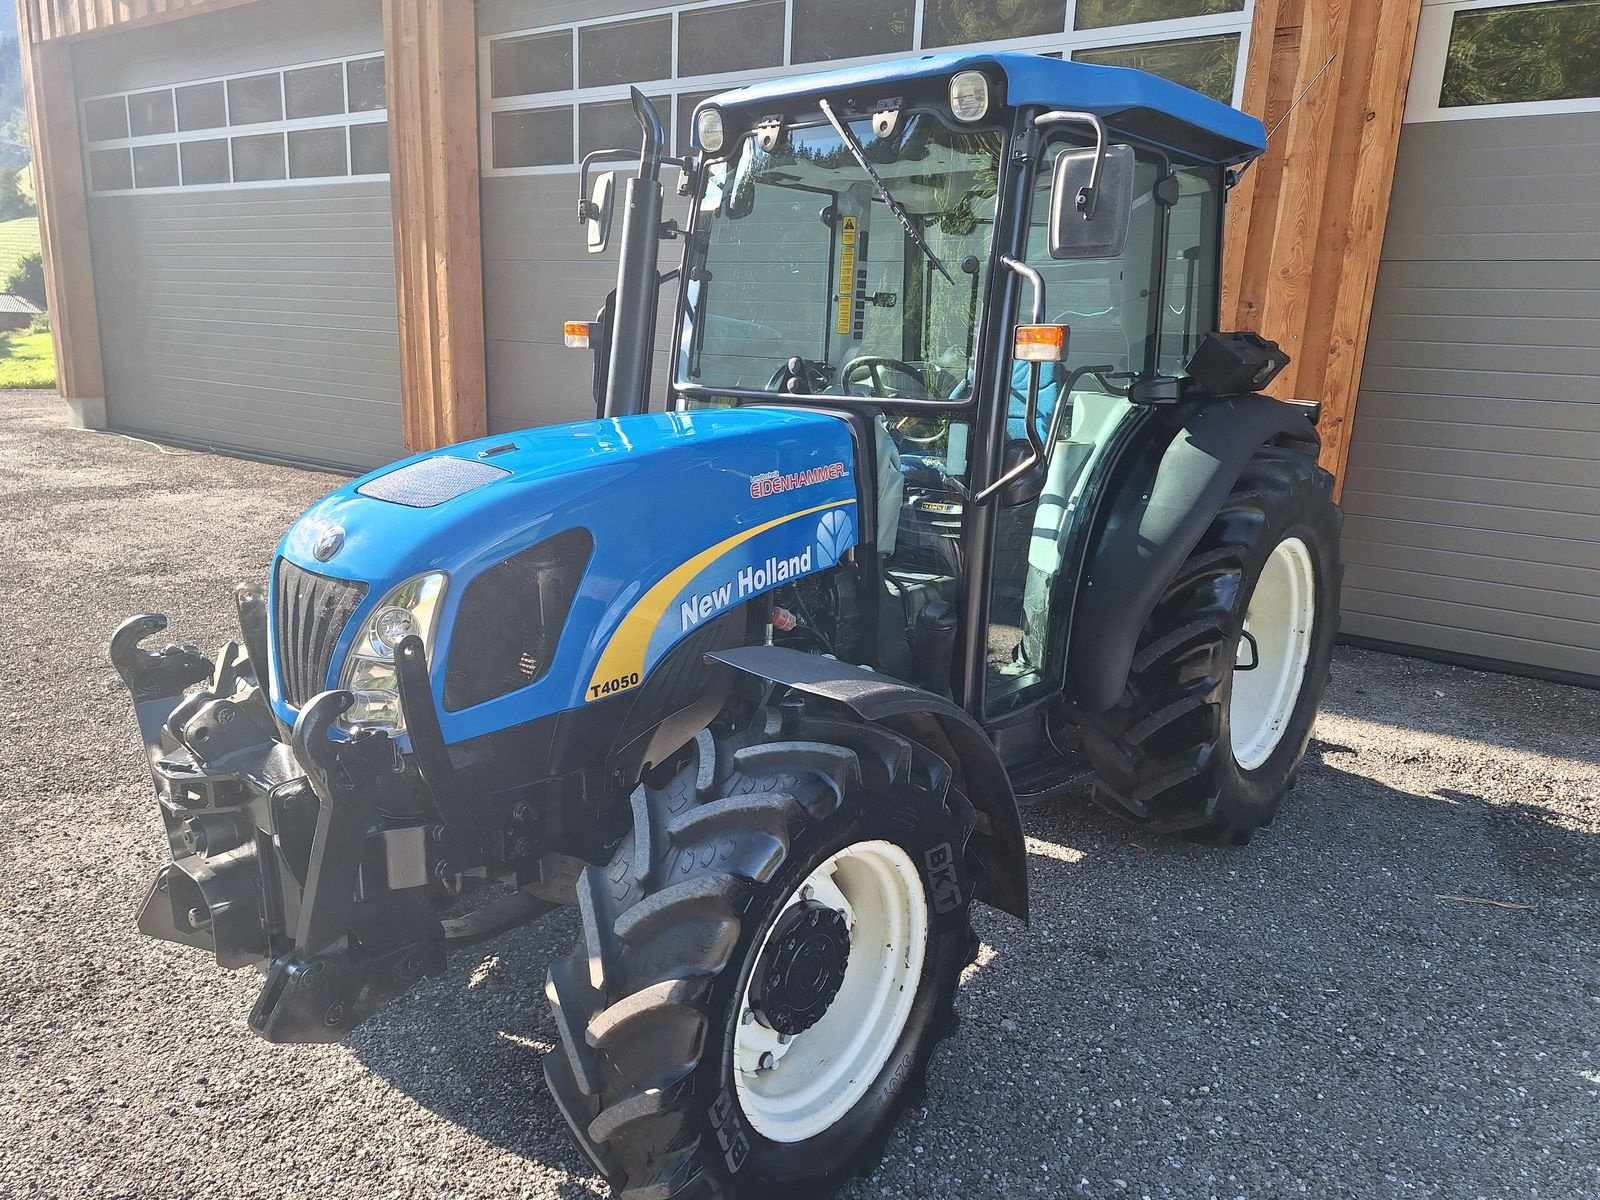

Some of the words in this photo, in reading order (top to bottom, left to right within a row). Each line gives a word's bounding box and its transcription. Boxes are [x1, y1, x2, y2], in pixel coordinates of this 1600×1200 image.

[750, 462, 844, 499] EIDENHAMMER
[680, 581, 733, 632] New
[737, 545, 812, 599] Holland
[590, 672, 639, 698] T4050
[924, 842, 962, 913] BKT
[707, 1087, 750, 1173] BKT
